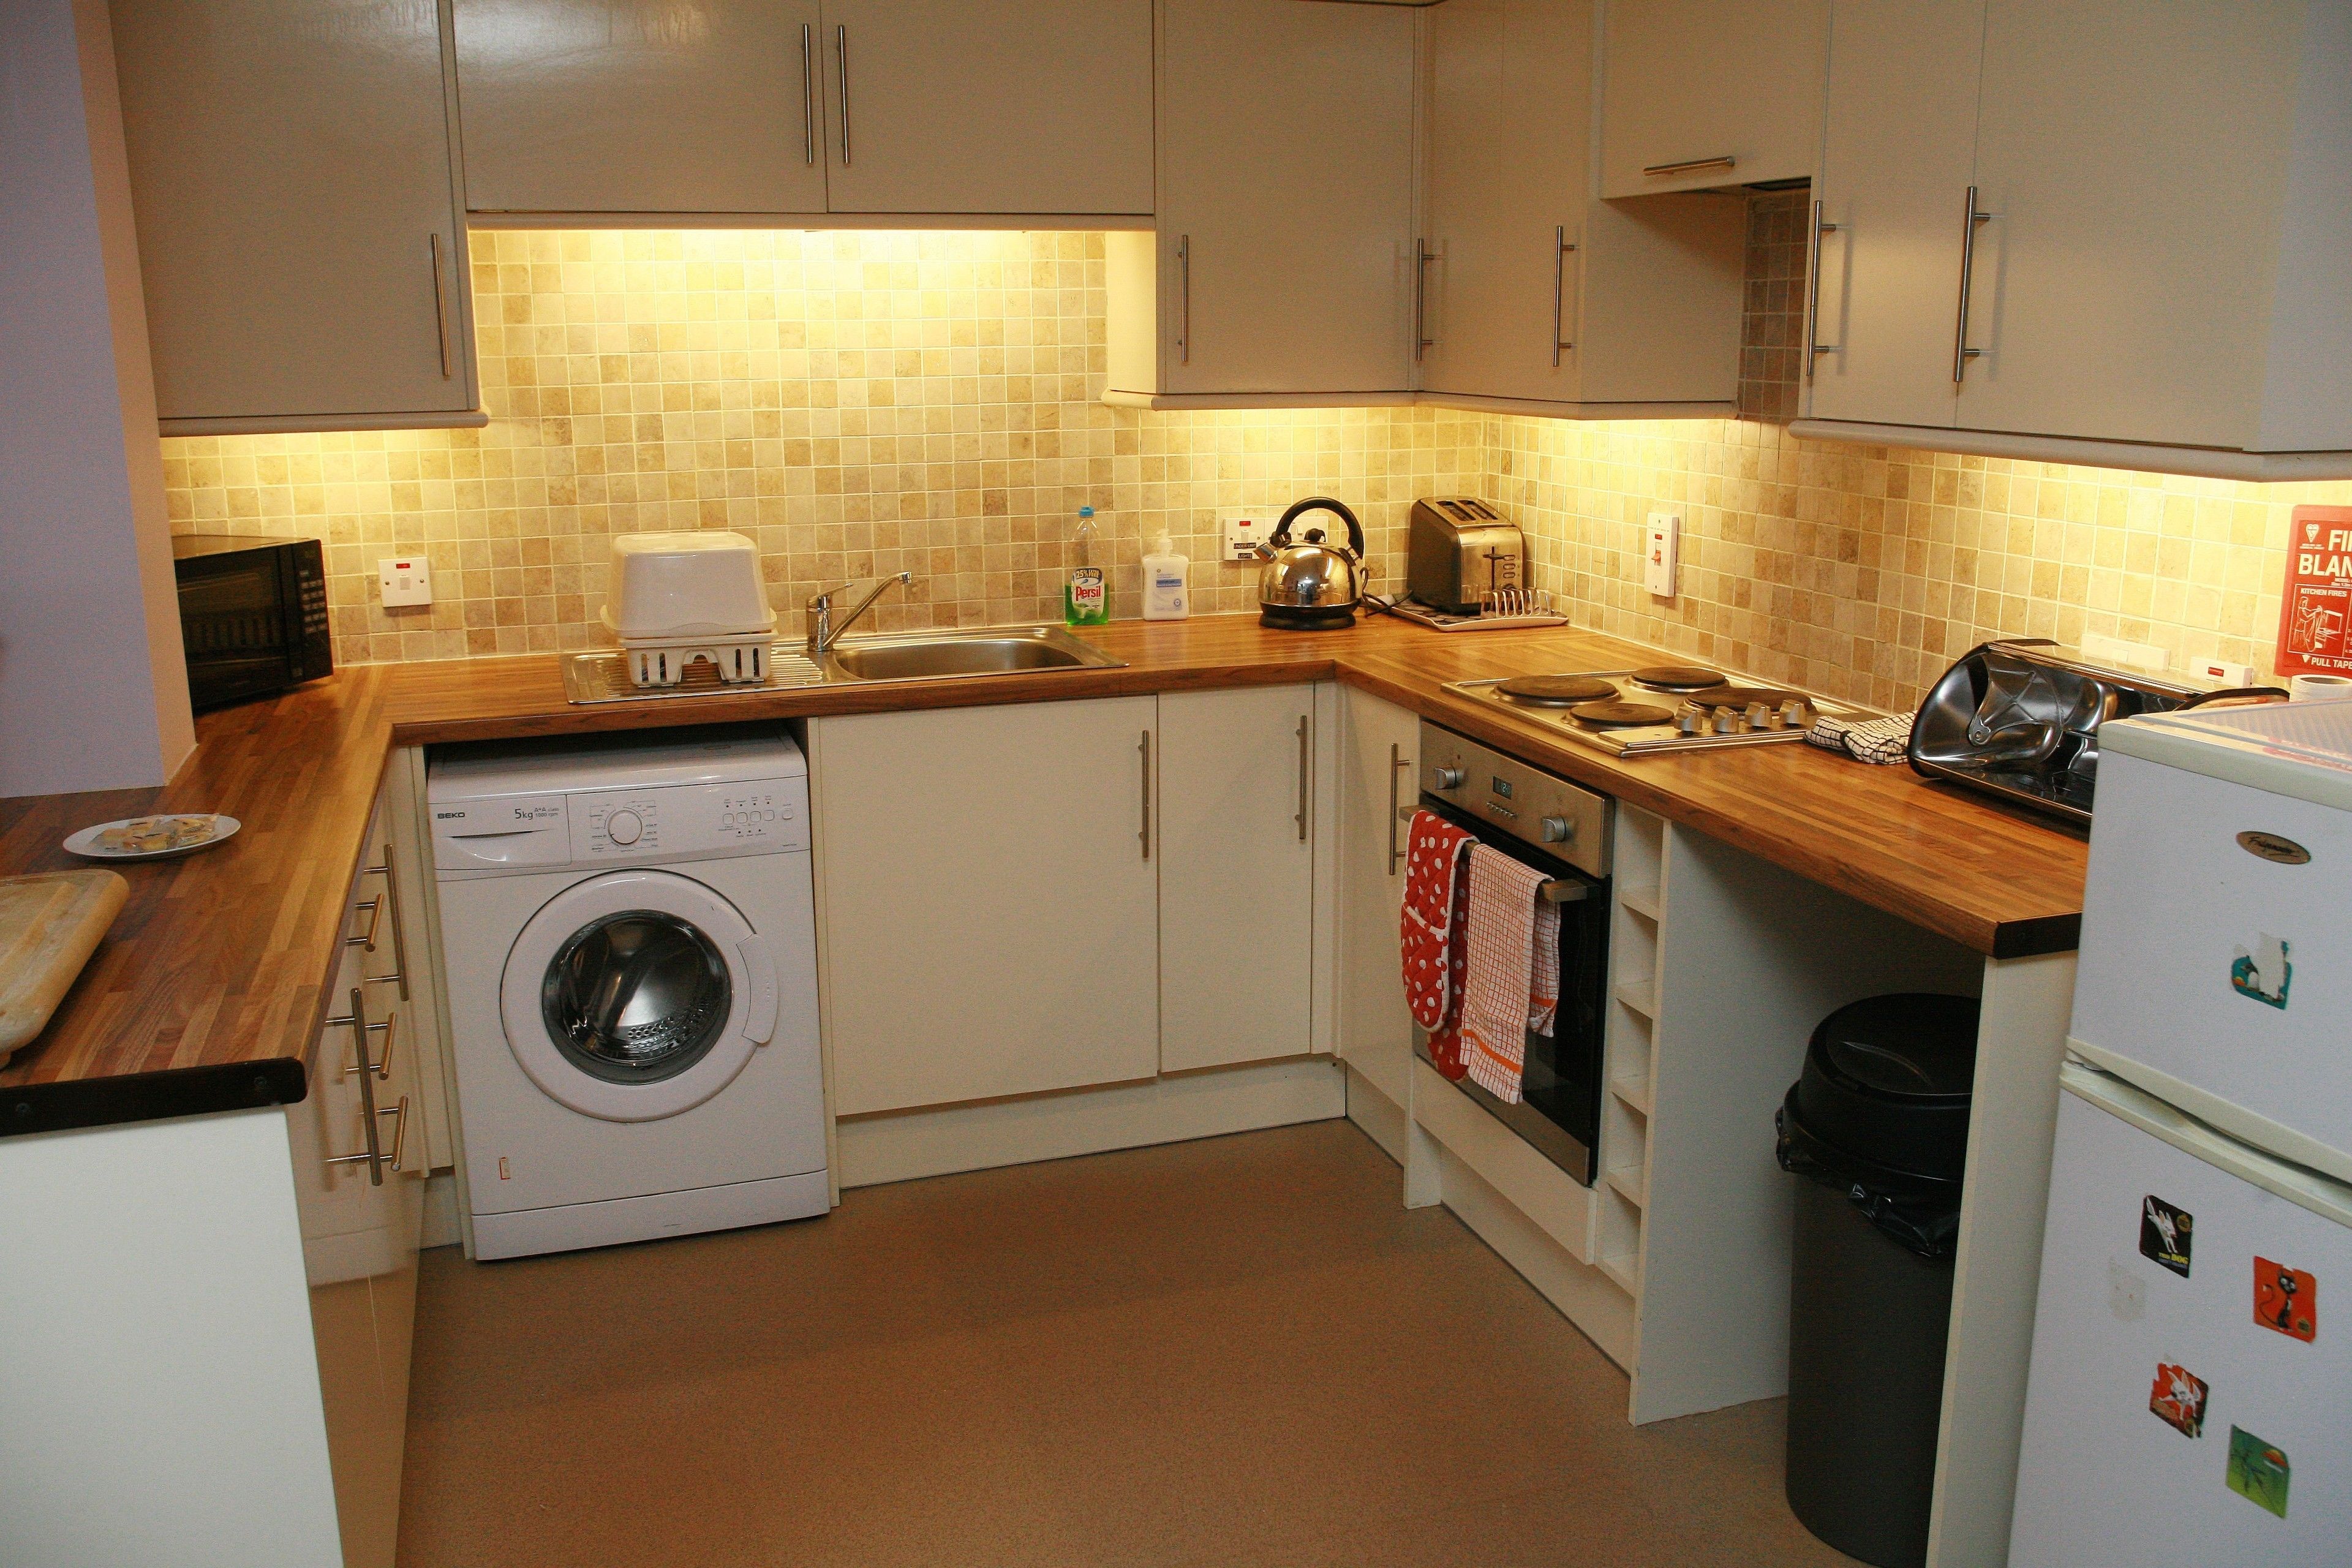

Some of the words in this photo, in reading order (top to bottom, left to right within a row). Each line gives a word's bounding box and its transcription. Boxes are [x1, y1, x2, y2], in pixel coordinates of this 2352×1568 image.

[1076, 585, 1101, 601] Persil
[2311, 657, 2331, 667] PULL
[514, 809, 533, 820] 5kg
